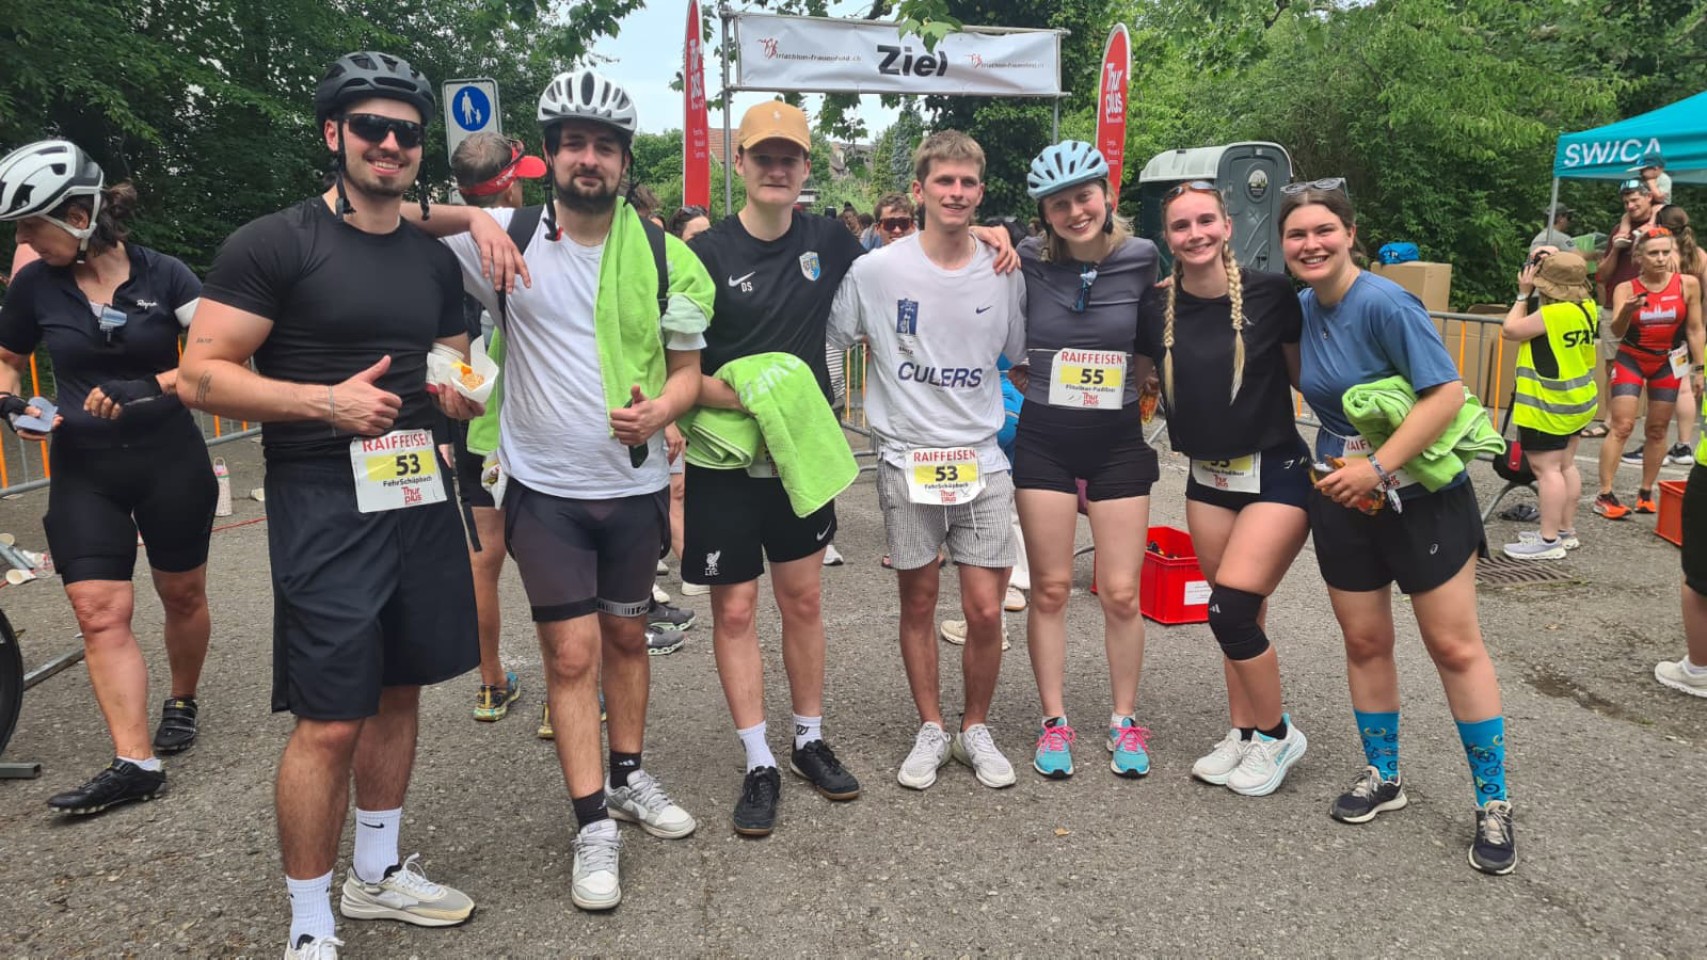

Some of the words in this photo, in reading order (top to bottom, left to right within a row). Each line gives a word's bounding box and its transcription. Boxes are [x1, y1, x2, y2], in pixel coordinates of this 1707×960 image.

[877, 44, 948, 77] Ziel
[1106, 62, 1123, 92] Thur
[1105, 91, 1123, 123] plus
[1563, 137, 1661, 167] SWICA
[741, 281, 753, 292] DS
[1061, 351, 1123, 365] RAIFFEISEN
[898, 361, 983, 388] CULERS
[1080, 368, 1105, 385] 55
[1082, 392, 1099, 401] Thur
[913, 449, 977, 462] RAIFFEISEN
[396, 453, 421, 476] 53
[935, 465, 959, 482] 53
[401, 486, 420, 496] Thur
[404, 495, 423, 505] plus
